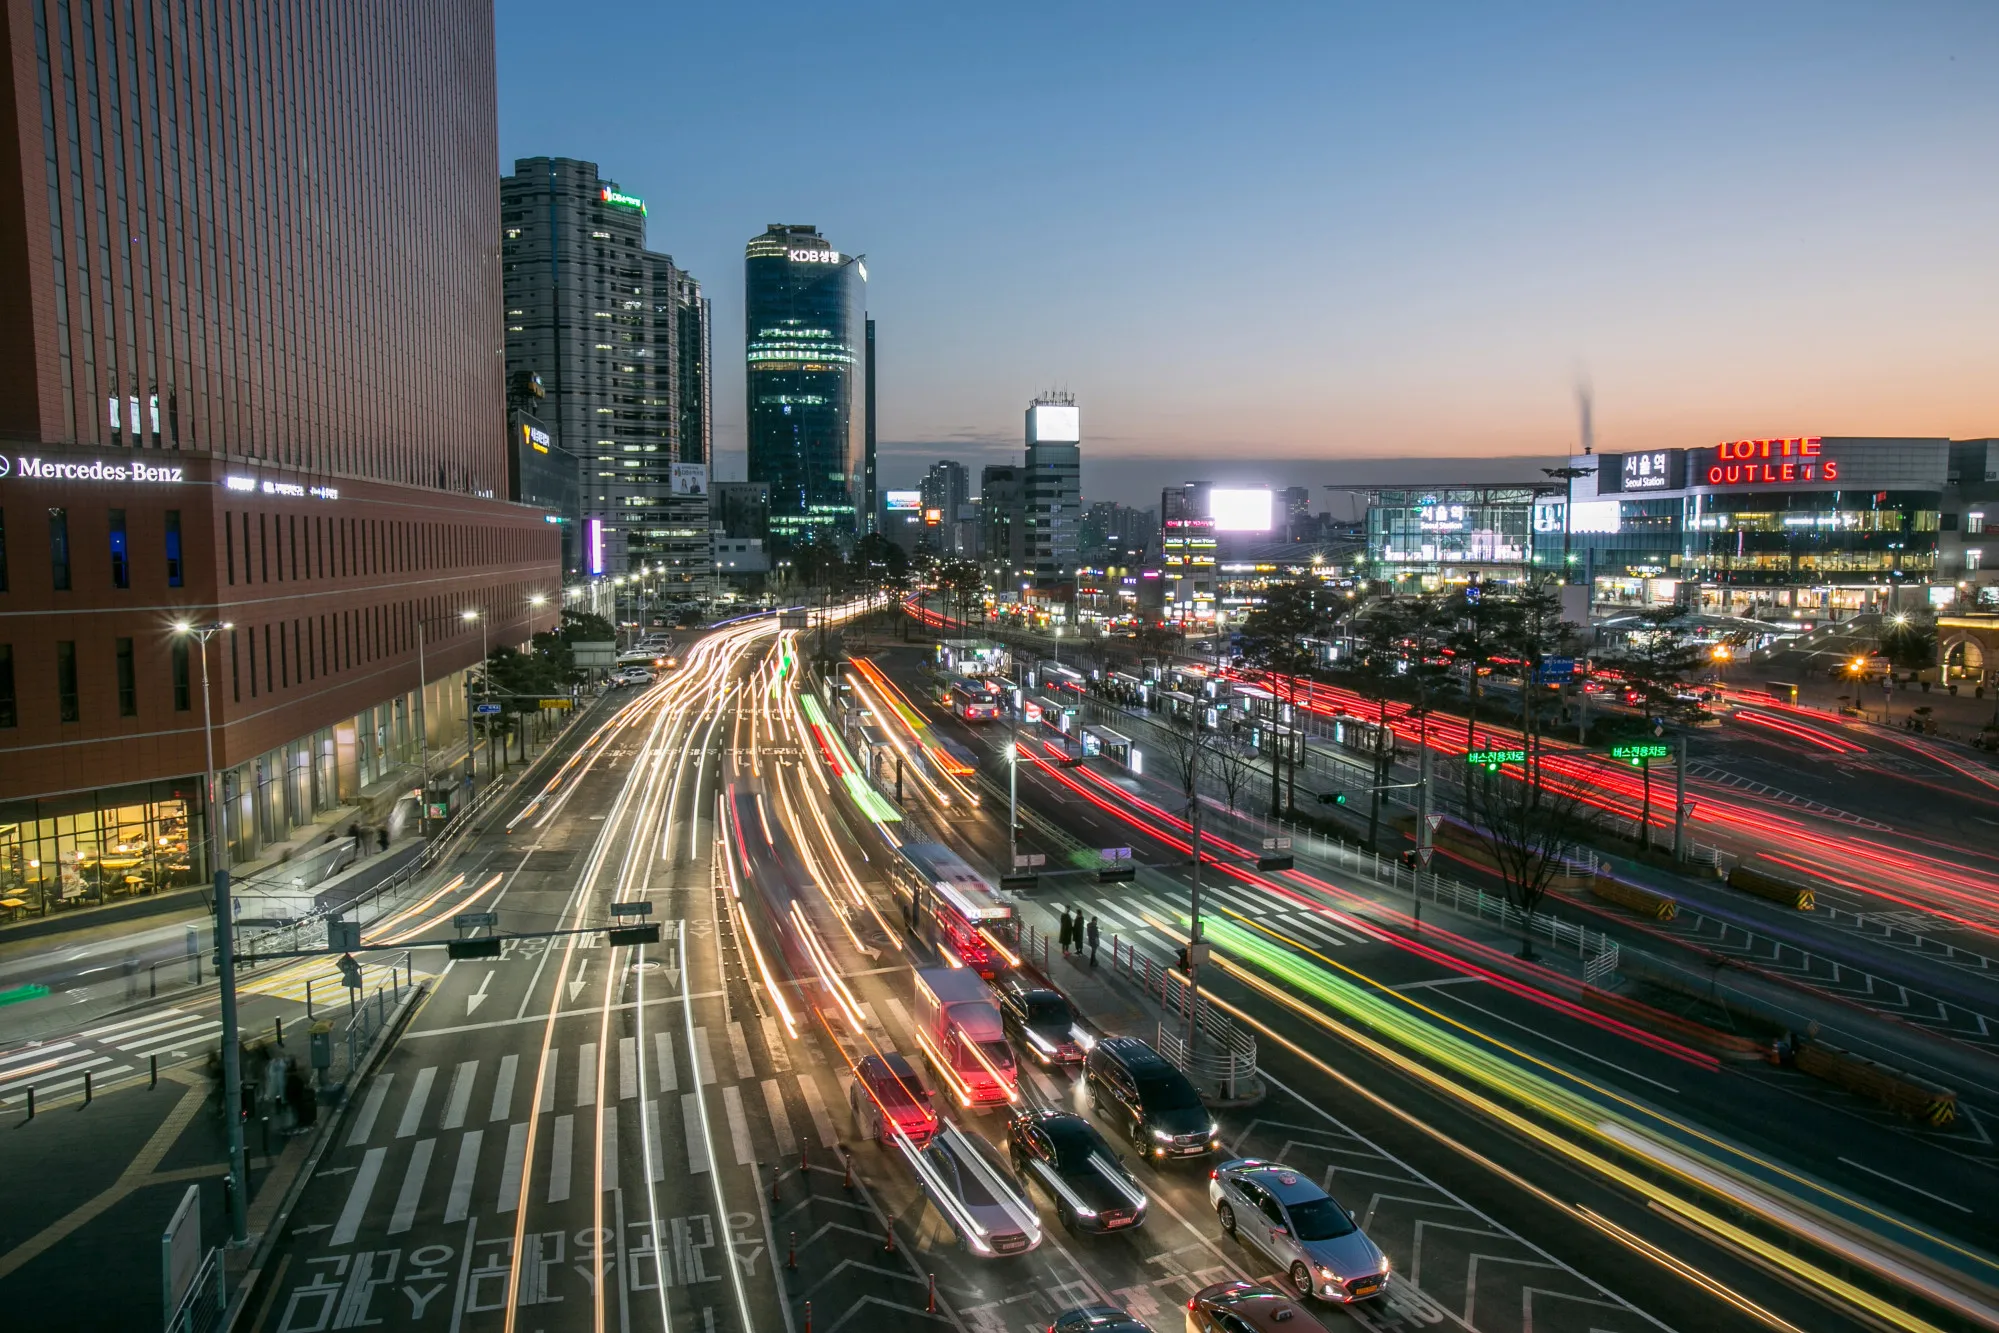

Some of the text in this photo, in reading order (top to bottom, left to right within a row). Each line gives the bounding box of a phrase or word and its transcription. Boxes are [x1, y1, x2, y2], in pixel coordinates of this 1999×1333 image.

[790, 249, 839, 264] KDB생명
[1720, 437, 1822, 461] LOTTE
[18, 456, 182, 483] Mercedes-Benz
[1625, 453, 1666, 476] 서울역
[1625, 475, 1665, 488] Seoul Station
[1420, 504, 1463, 522] 서울역
[1420, 521, 1463, 530] Seoul Station
[1469, 750, 1525, 763] 버스전용차로
[1613, 745, 1667, 758] 버스전용차로
[629, 1212, 767, 1292] 숭례문
[465, 1226, 616, 1314] 숭례문
[277, 1244, 456, 1333] 숭례문
